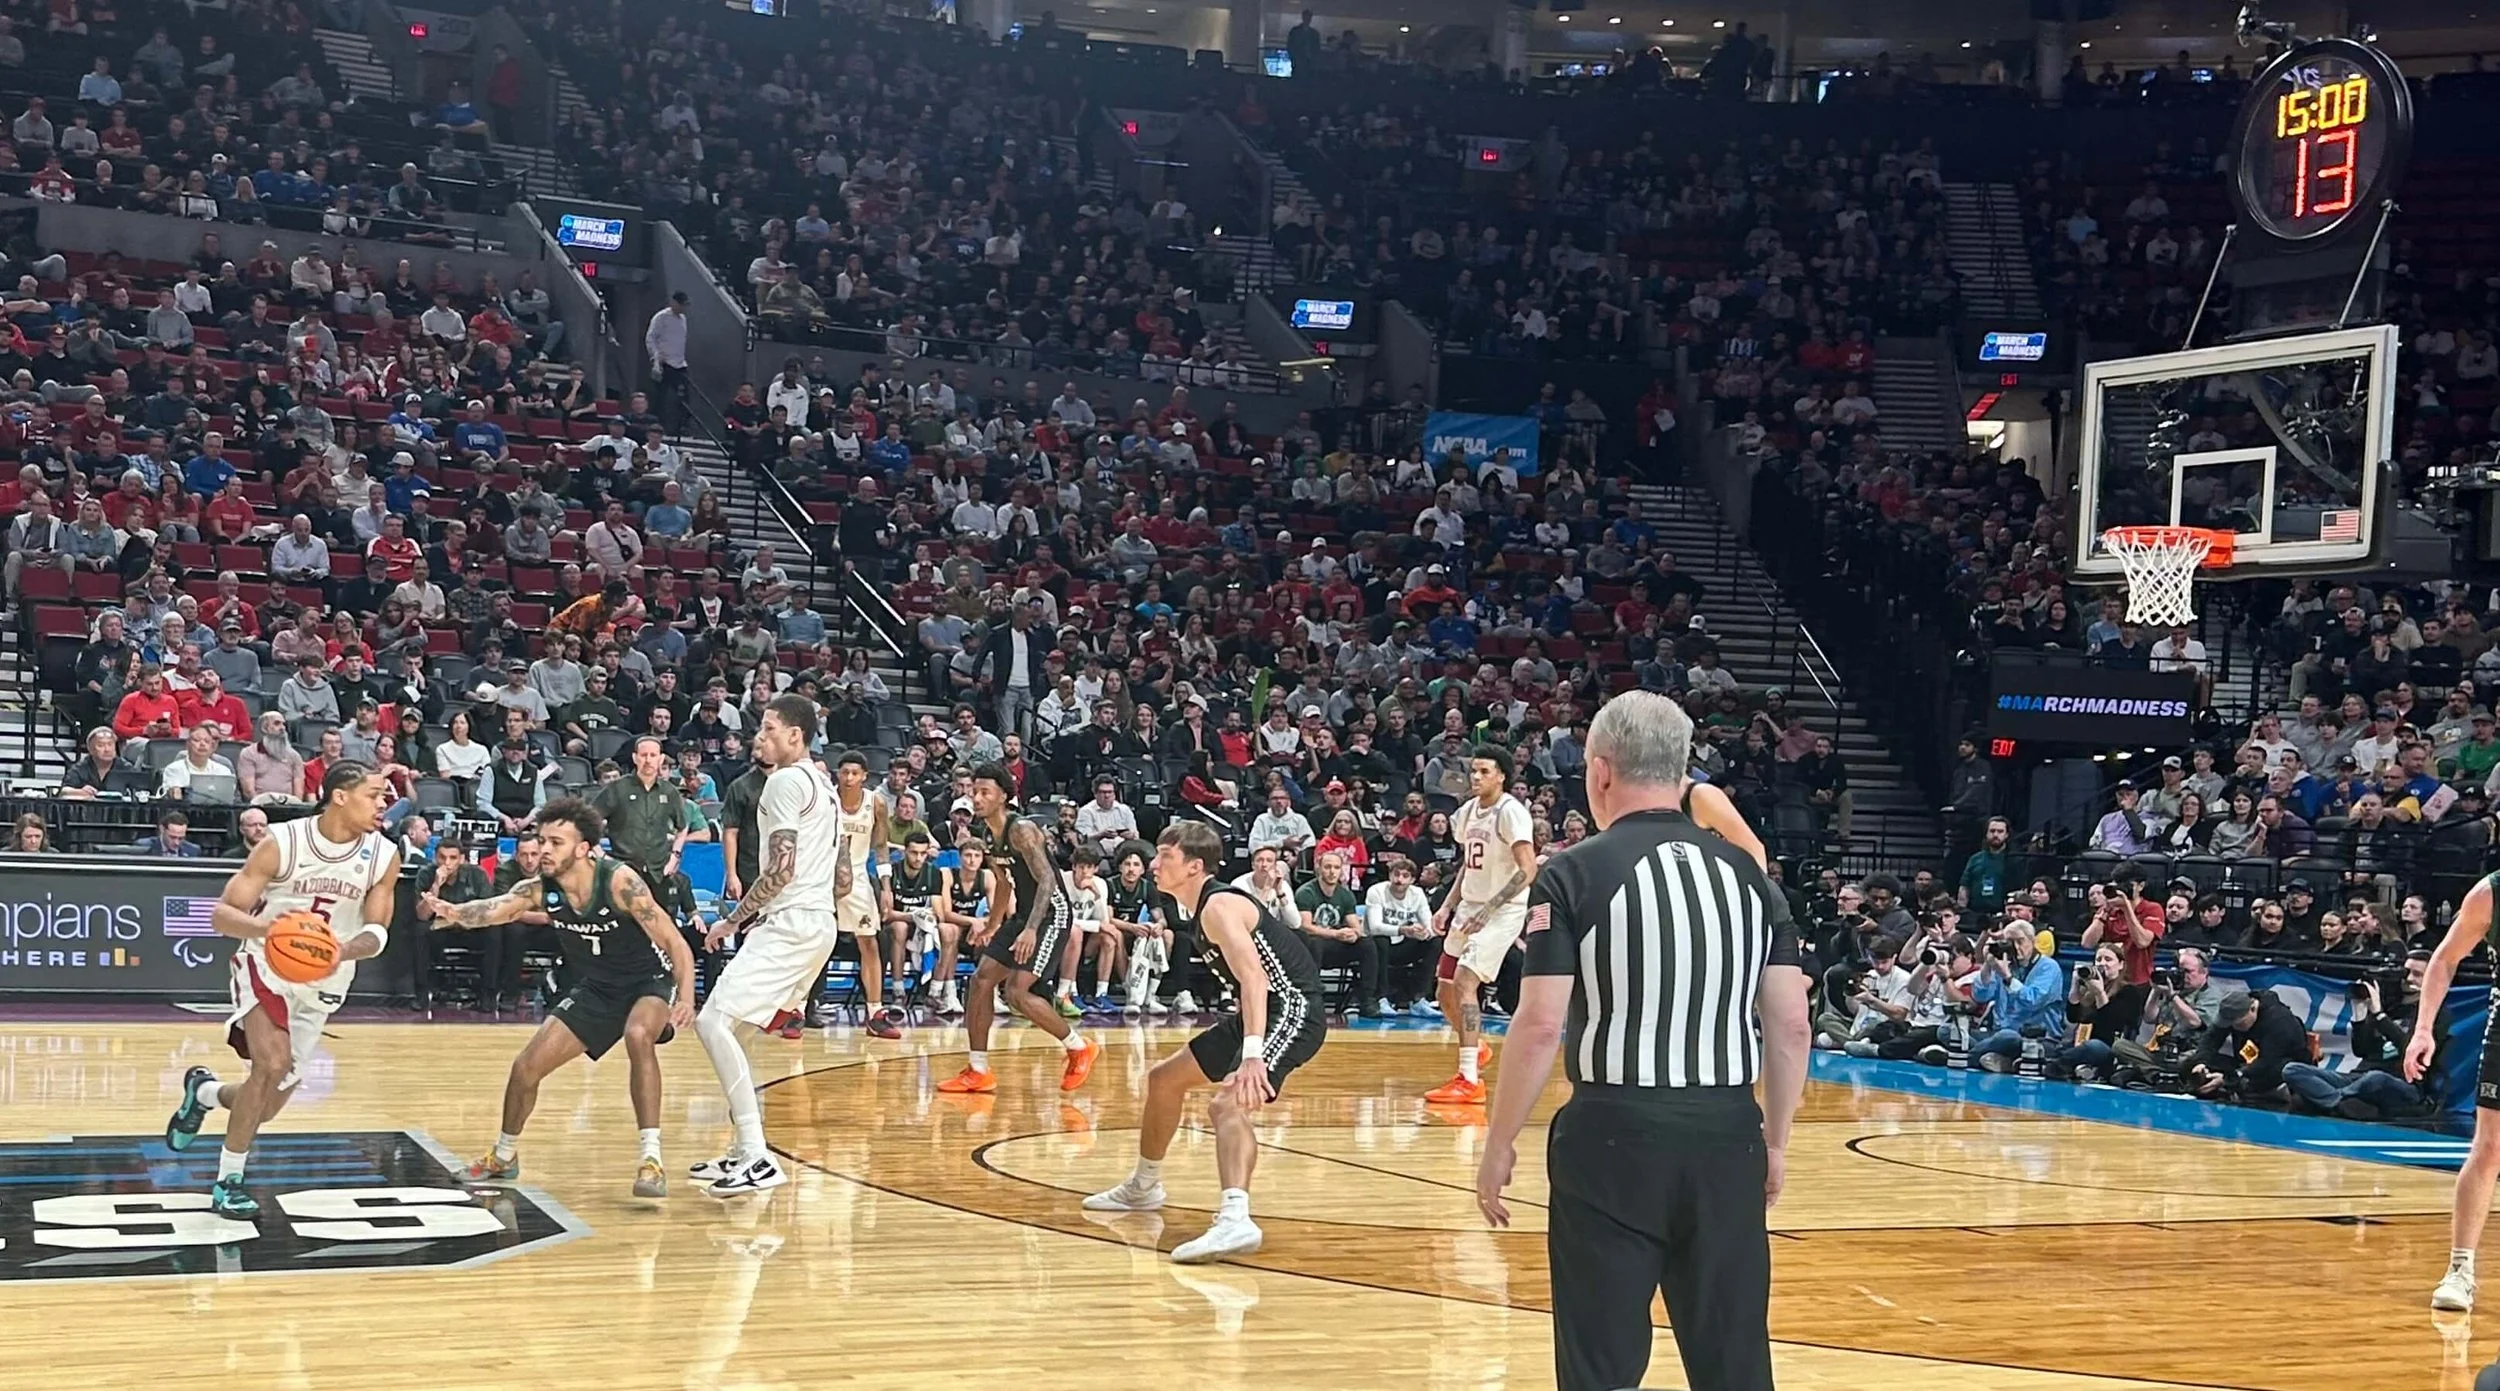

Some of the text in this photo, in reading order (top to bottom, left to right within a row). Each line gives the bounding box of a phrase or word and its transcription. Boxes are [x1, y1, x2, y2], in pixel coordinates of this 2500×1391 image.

[2277, 78, 2368, 138] 15:00
[2294, 129, 2355, 217] 13
[573, 219, 606, 232] MARCH
[575, 231, 621, 245] MADNESS
[1997, 694, 2187, 718] #MARCHMADNESS
[1467, 842, 1484, 869] 12
[292, 877, 362, 901] RAZORBACKS
[0, 892, 141, 948] pians
[2, 950, 87, 967] HERE
[0, 1187, 506, 1248] SS
